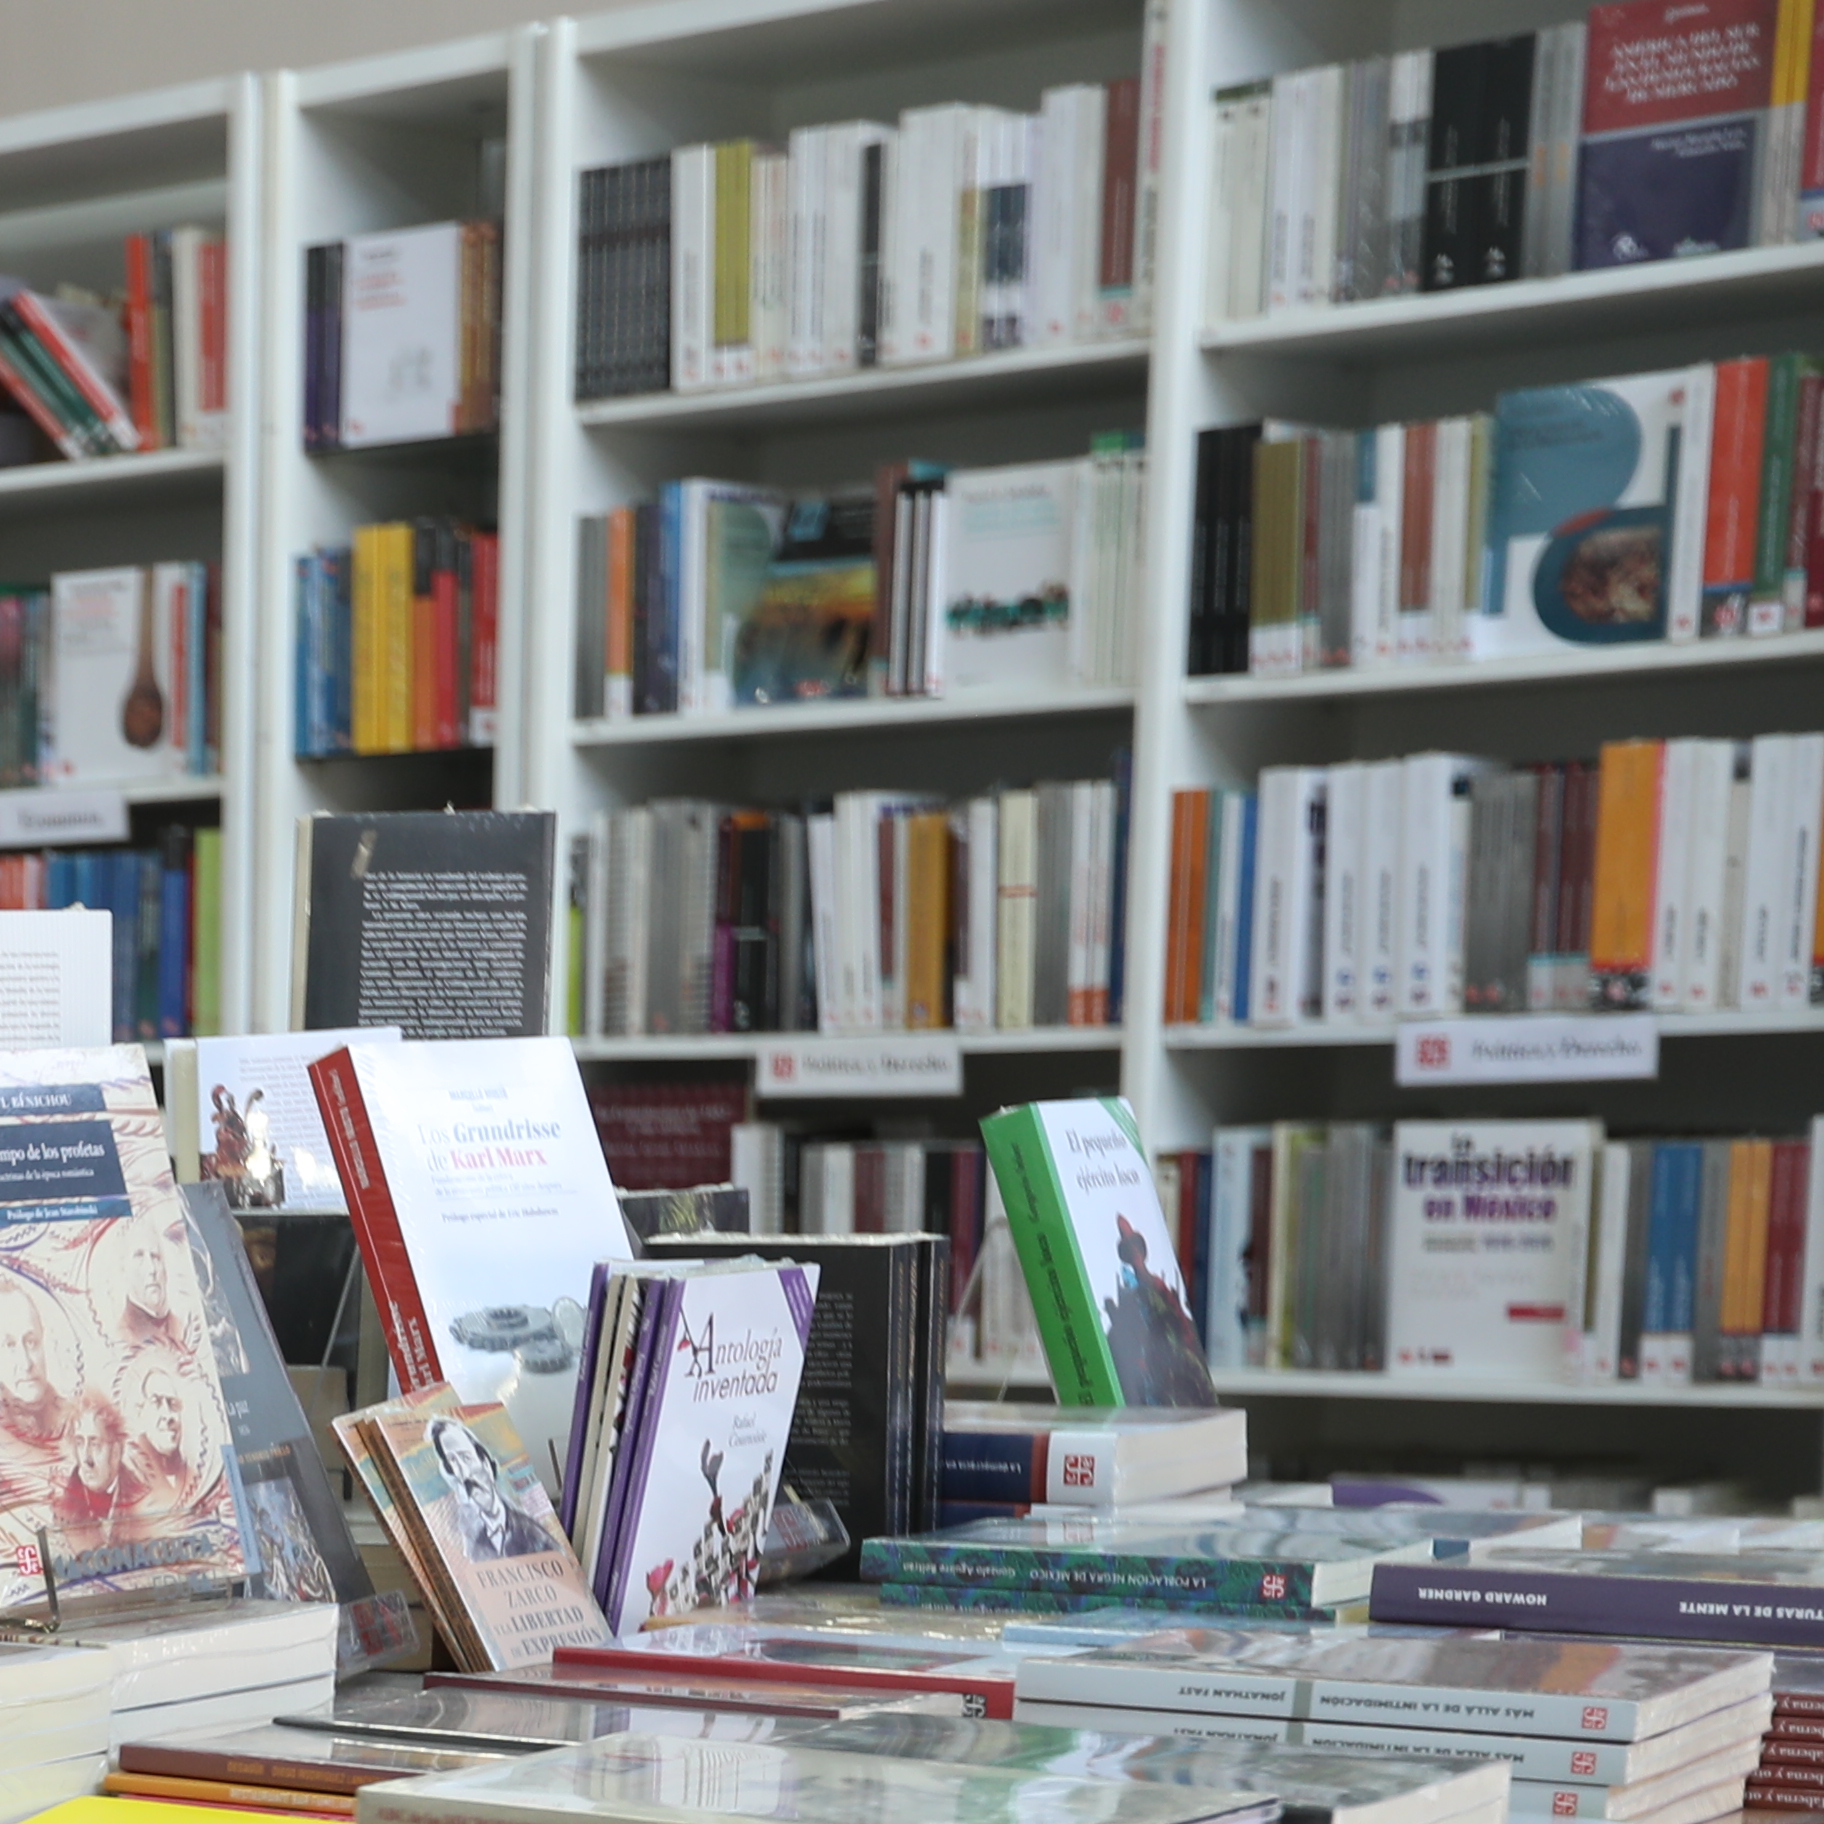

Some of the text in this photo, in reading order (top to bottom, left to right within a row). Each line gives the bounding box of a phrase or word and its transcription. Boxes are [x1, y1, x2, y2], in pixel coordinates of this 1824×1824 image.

[418, 1118, 562, 1146] Los Grundrisse
[27, 1143, 41, 1160] de
[42, 1143, 60, 1160] los
[61, 1140, 106, 1163] profetas
[1065, 1128, 1128, 1160] El pequeño
[427, 1146, 549, 1172] de Karl Marx
[1075, 1162, 1142, 1197] ejército loco
[684, 1311, 783, 1376] Antología
[693, 1368, 779, 1403] inventada
[476, 1559, 564, 1589] FRANCISCO
[938, 1562, 974, 1579] Aguirre
[974, 1564, 1016, 1581] Gonzalo
[1028, 1568, 1071, 1584] MÉXICO
[1072, 1569, 1087, 1583] DE
[1088, 1570, 1125, 1585] NEGRA
[1127, 1572, 1190, 1590] POBLACIÓN
[1191, 1575, 1207, 1589] LA
[503, 1584, 558, 1609] ZARCO
[1417, 1587, 1547, 1607] HOWARD GARDNER
[511, 1605, 585, 1634] LIBERTAD
[1679, 1601, 1730, 1616] MENTE
[1732, 1604, 1751, 1617] LA
[1753, 1604, 1773, 1618] DE
[520, 1625, 603, 1657] EXPRESIÓN
[1178, 1685, 1534, 1721] MÁS ALLÁ DE LA INTIMIDACIÓN JONATHAN FAST
